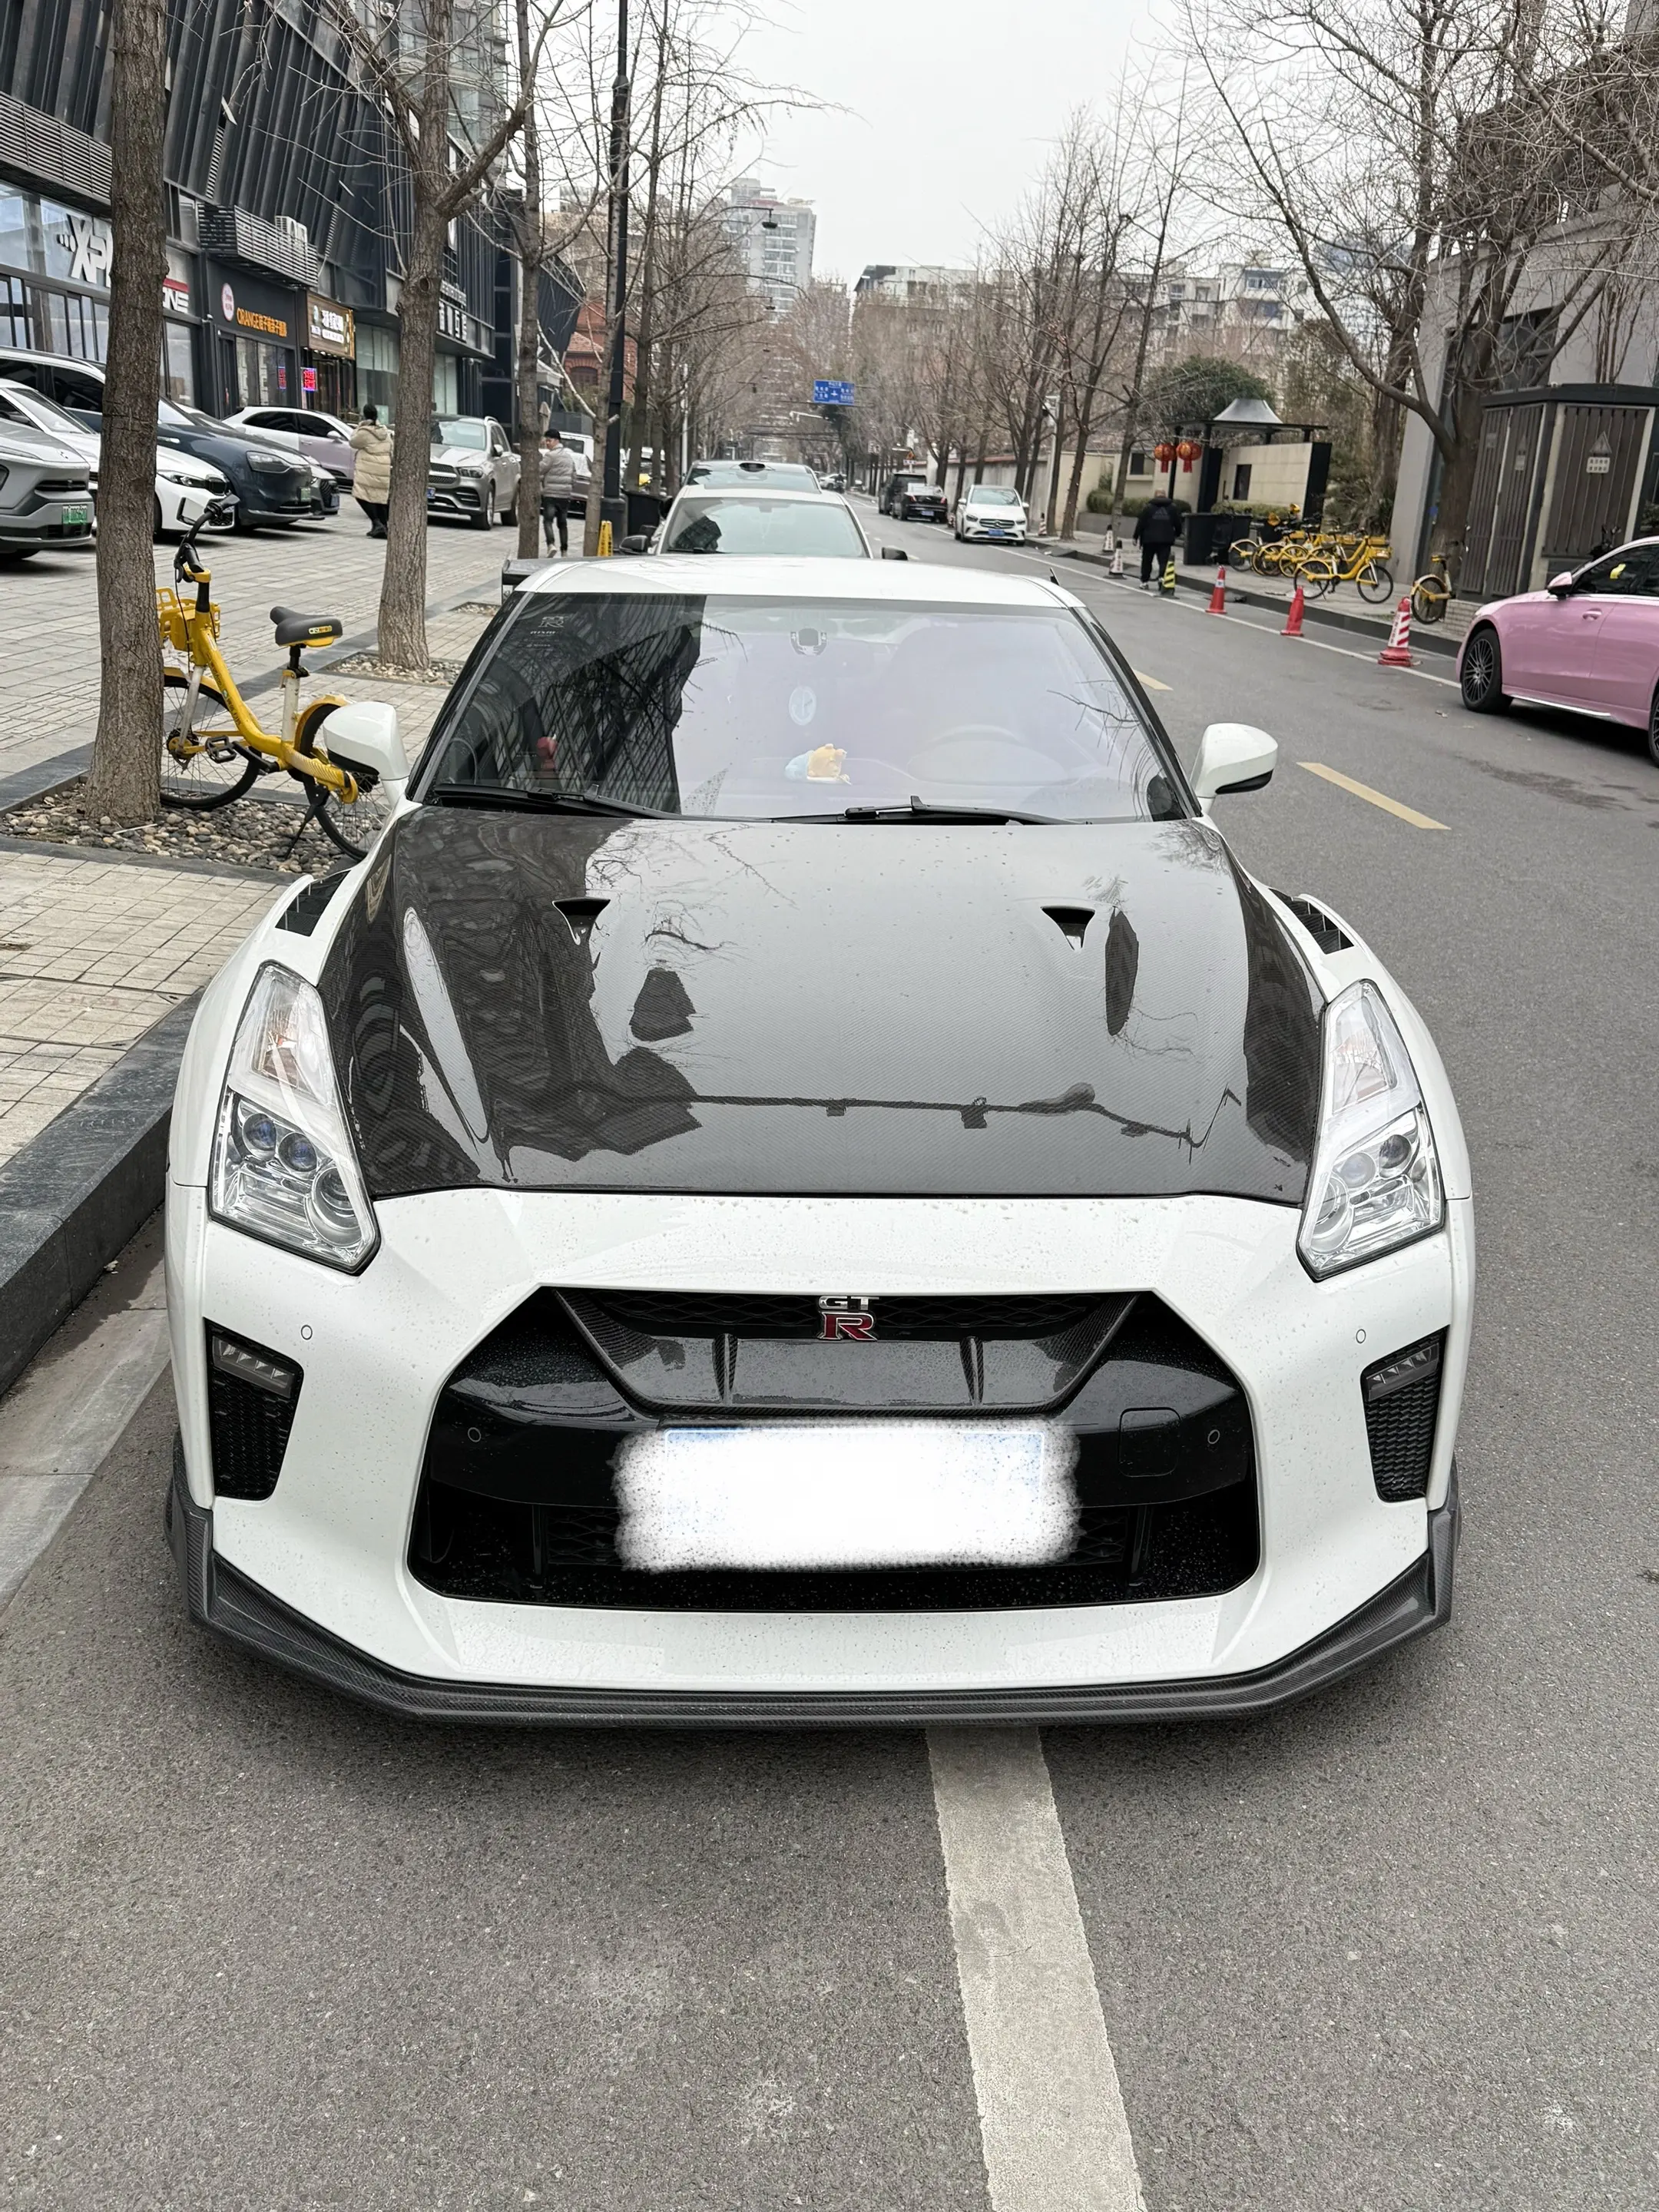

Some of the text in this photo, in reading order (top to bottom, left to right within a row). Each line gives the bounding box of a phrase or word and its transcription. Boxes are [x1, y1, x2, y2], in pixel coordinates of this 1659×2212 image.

[70, 214, 113, 288] XP
[819, 1295, 879, 1310] GT
[820, 1311, 878, 1340] R
